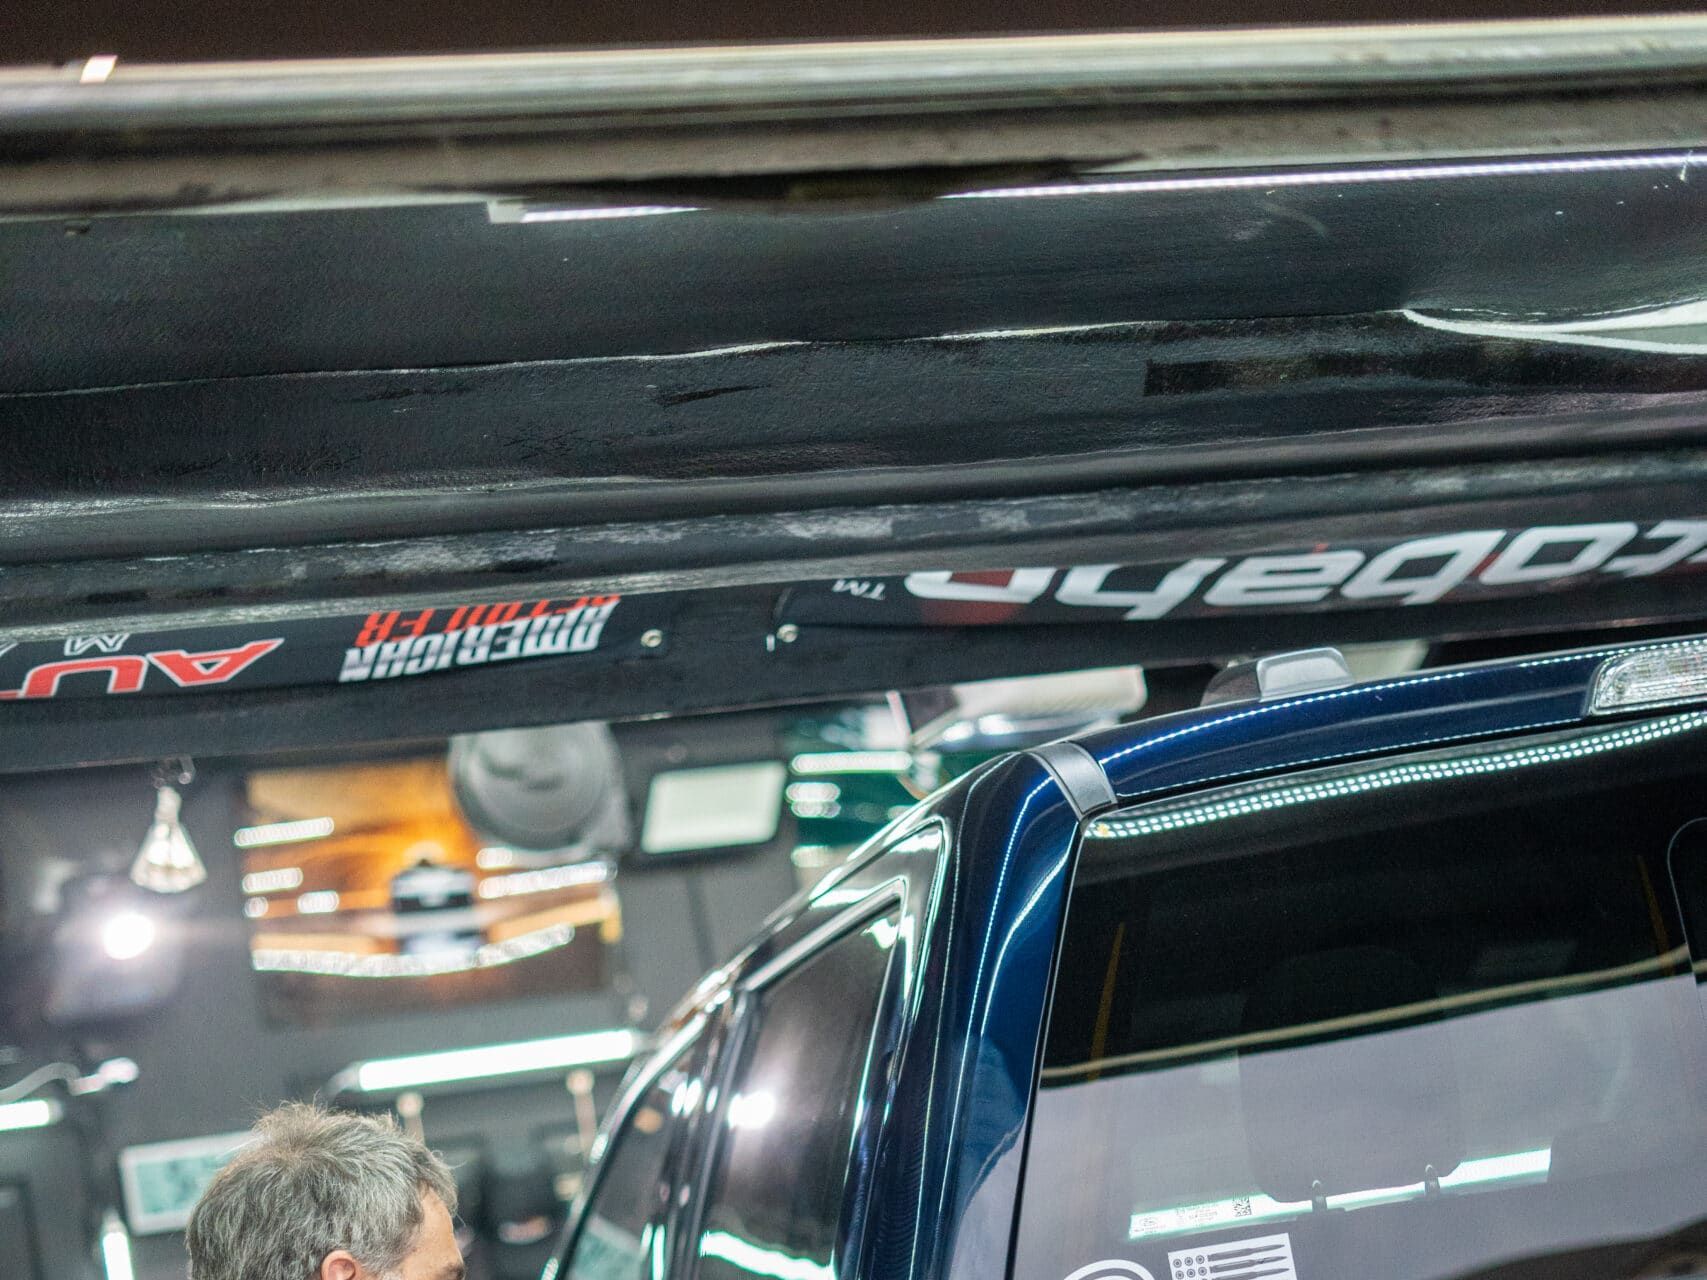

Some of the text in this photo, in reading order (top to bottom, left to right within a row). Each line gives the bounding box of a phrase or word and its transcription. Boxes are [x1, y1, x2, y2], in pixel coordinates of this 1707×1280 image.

[903, 519, 1707, 622] tobahn
[0, 637, 285, 700] AU
[338, 600, 621, 682] AMERICAN
